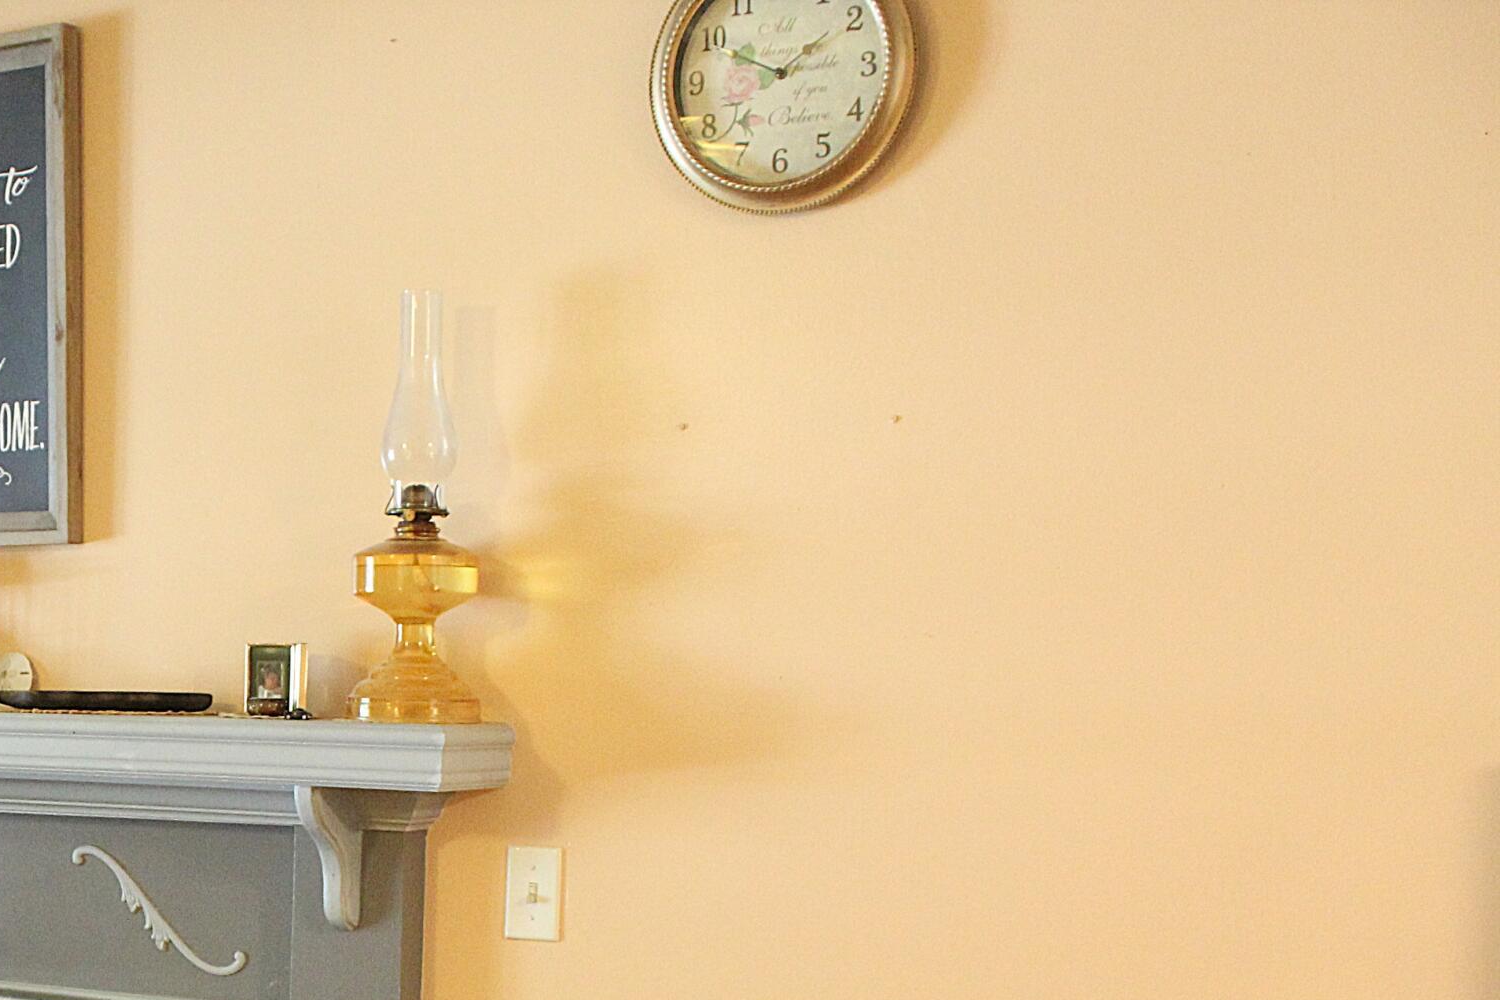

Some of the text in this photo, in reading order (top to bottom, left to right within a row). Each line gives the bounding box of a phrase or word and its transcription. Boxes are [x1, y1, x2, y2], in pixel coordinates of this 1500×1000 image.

[846, 5, 863, 32] 2
[701, 25, 726, 51] 10
[861, 51, 877, 77] 3
[689, 71, 704, 96] 9
[847, 97, 864, 122] 4
[701, 114, 717, 139] 8
[735, 141, 750, 167] 7
[816, 132, 833, 158] 5
[772, 149, 788, 174] 6
